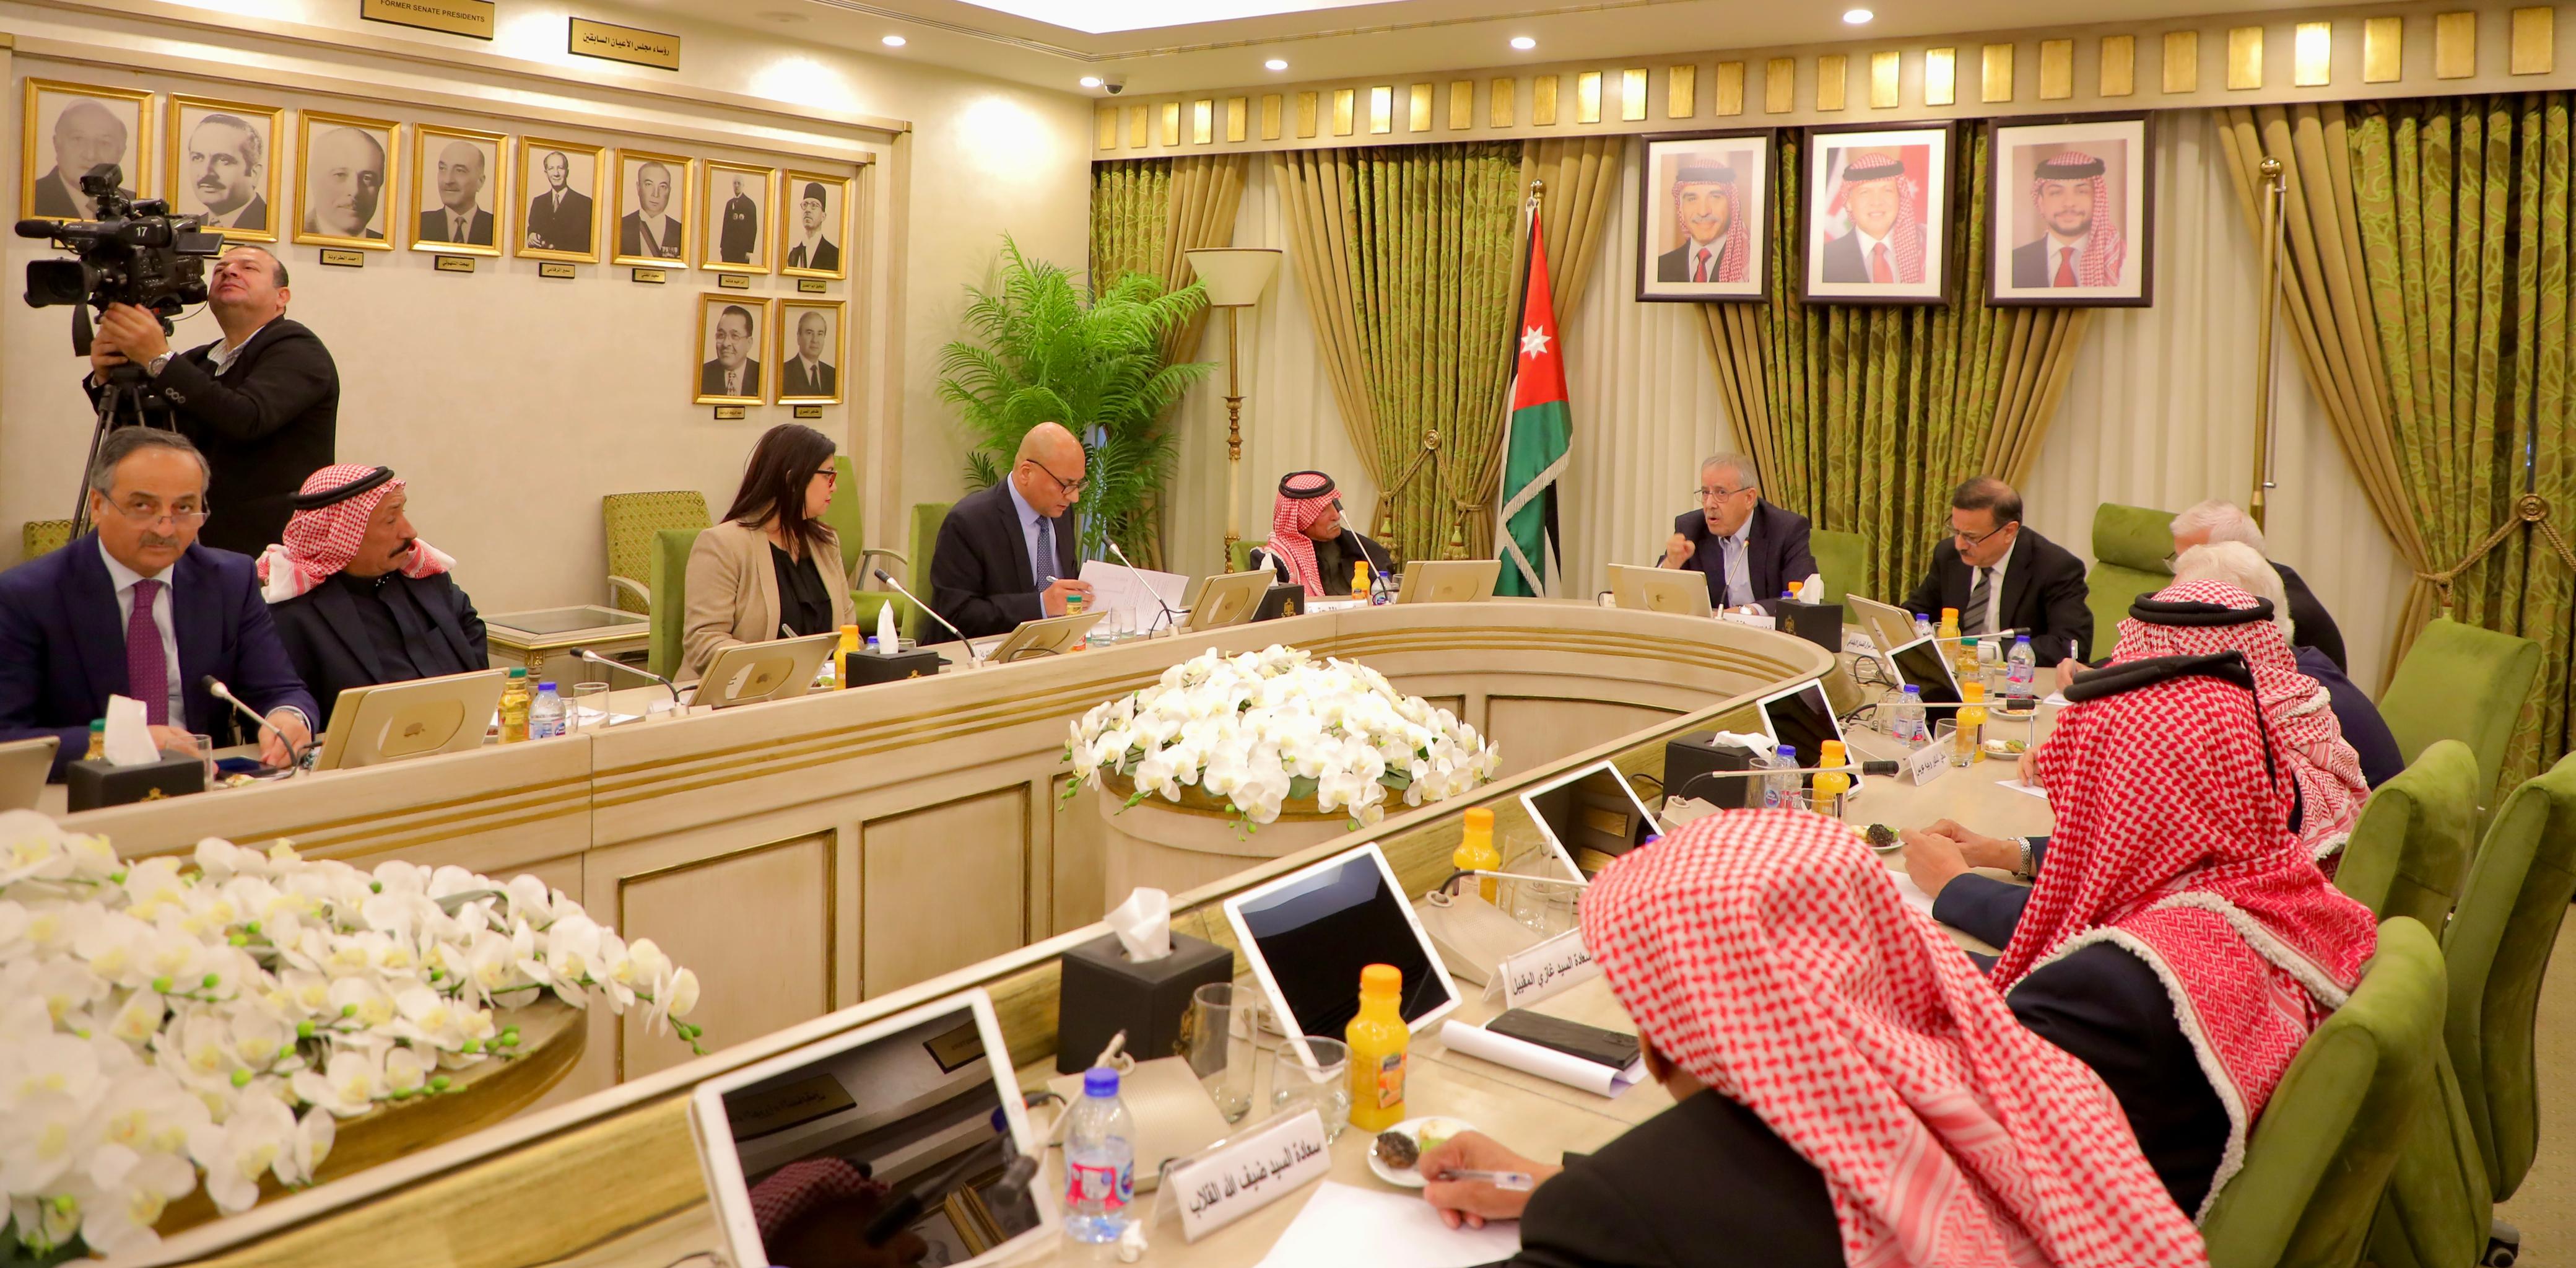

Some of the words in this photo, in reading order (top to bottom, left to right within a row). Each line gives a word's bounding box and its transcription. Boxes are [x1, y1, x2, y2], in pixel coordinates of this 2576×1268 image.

[380, 0, 411, 10] FORMER
[413, 5, 441, 15] SENATE
[442, 9, 485, 22] PRESIDENTS
[583, 32, 610, 45] السابقين
[611, 38, 633, 49] الأعيان
[634, 43, 651, 53] مجلس
[653, 45, 669, 56] رؤساء
[136, 226, 148, 237] 17
[1557, 956, 1573, 977] السيد
[1575, 951, 1591, 967] سعادة
[1538, 963, 1555, 987] غازي
[1295, 1139, 1322, 1164] سعادة
[1269, 1146, 1294, 1179] السيد
[1224, 1171, 1238, 1197] الله
[1238, 1161, 1268, 1192] ضيف
[1189, 1181, 1221, 1218] القلاب
